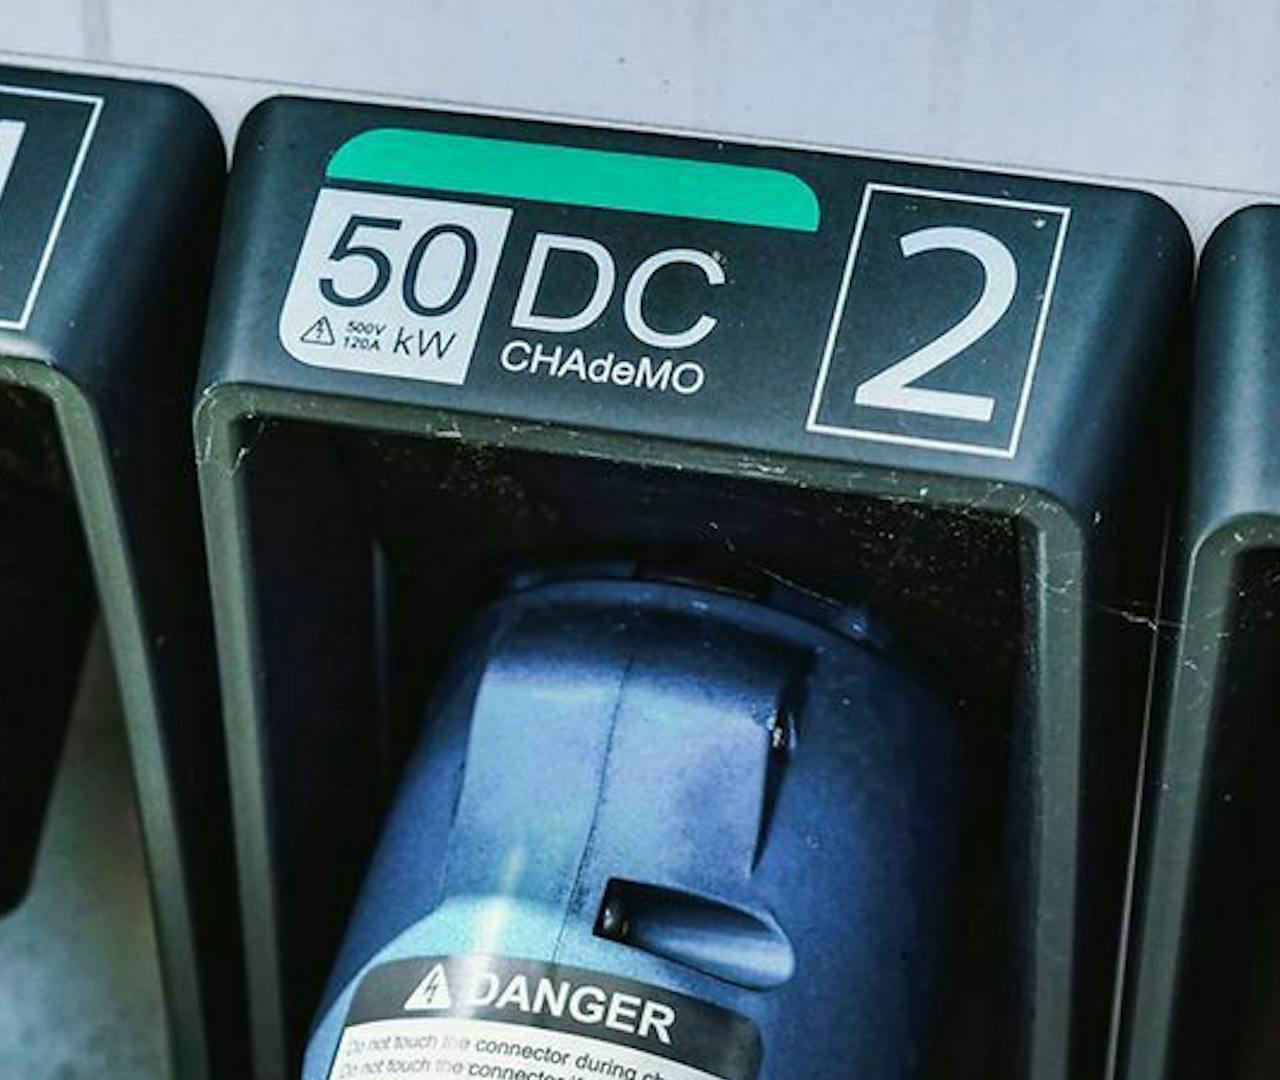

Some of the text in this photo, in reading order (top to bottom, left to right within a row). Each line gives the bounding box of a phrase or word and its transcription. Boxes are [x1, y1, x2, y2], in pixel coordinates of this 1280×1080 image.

[319, 214, 479, 317] 50
[510, 232, 727, 349] DC
[348, 320, 388, 336] 500V
[393, 326, 457, 360] kW
[853, 226, 1020, 423] 2
[500, 340, 705, 395] CHAdeMO
[470, 972, 677, 1046] DANGER
[386, 1057, 430, 1074] touch
[393, 1033, 438, 1051] touch
[476, 1037, 571, 1067] connector
